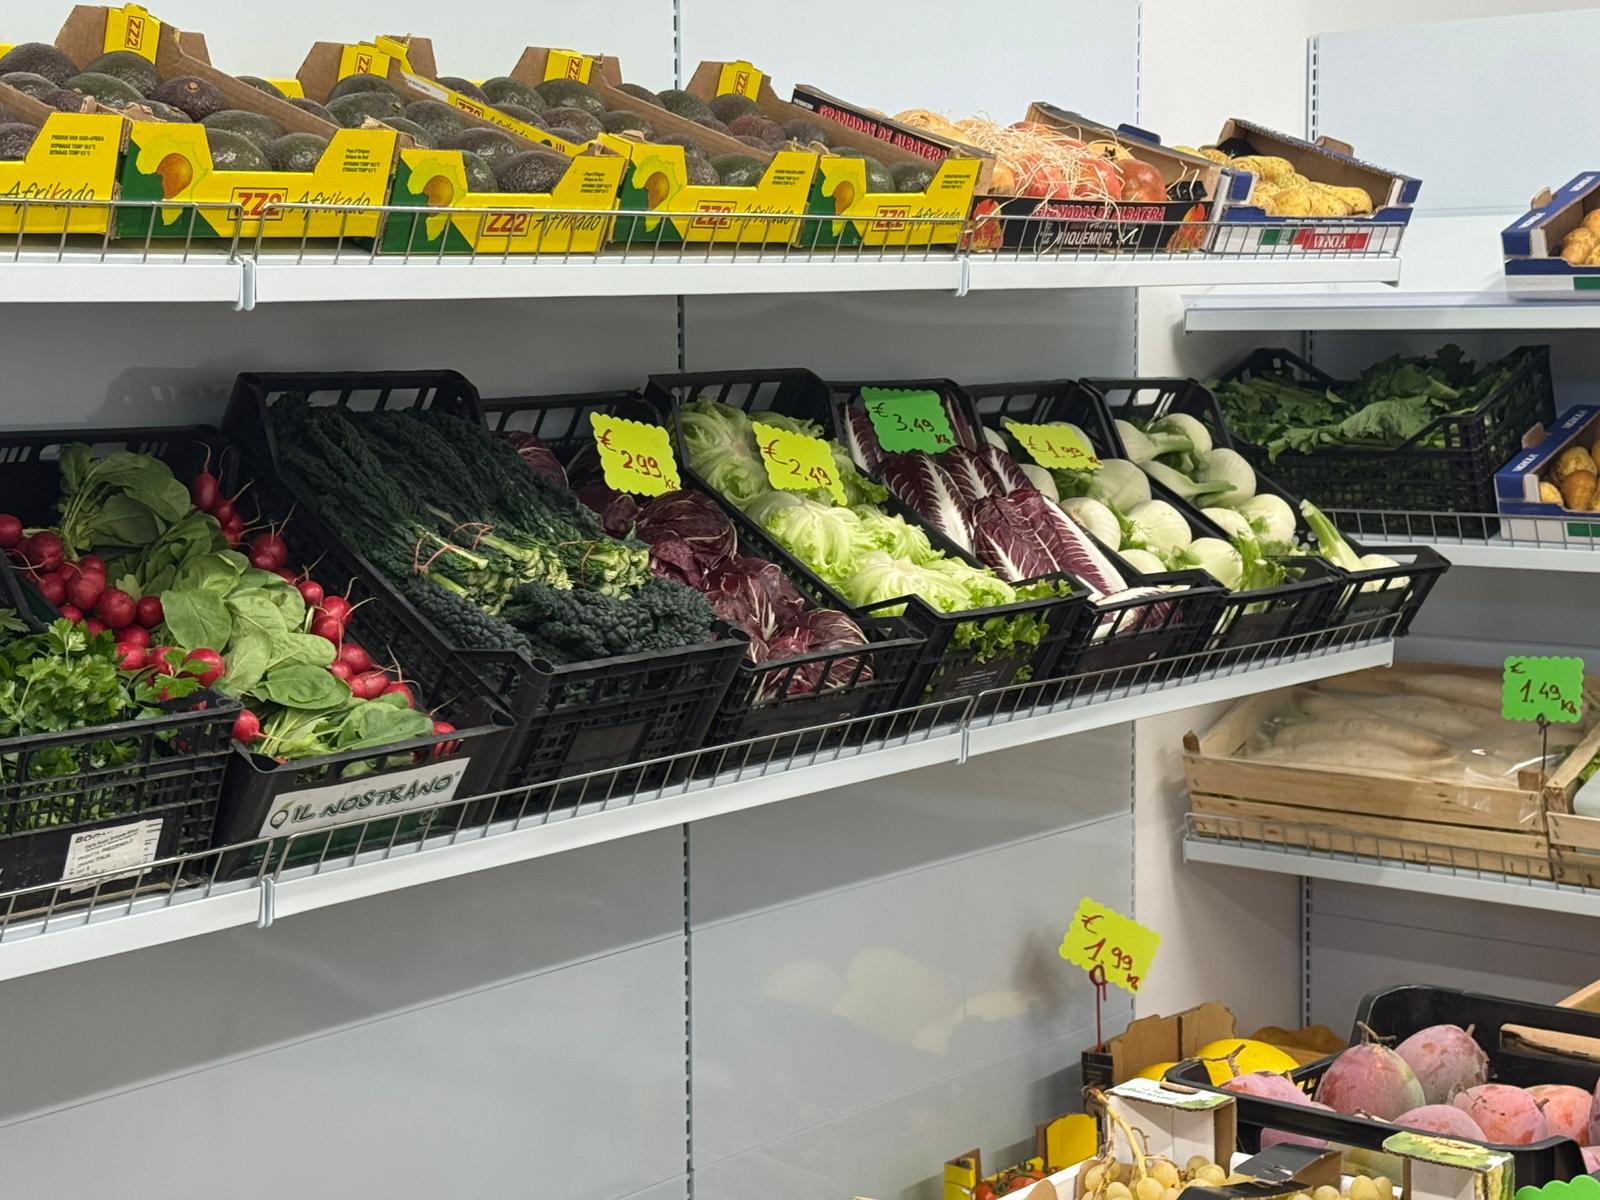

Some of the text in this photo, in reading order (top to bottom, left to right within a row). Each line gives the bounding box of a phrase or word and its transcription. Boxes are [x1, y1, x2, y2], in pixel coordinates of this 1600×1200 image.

[126, 18, 142, 47] ZZ2
[357, 56, 370, 74] ZZ
[234, 191, 371, 220] ZZ2 Afrikado
[695, 205, 733, 226] ZZ2
[486, 211, 529, 233] ZZ2
[871, 401, 889, 418] €
[892, 413, 936, 433] 3.49
[762, 438, 833, 486] € 2.49
[1520, 678, 1562, 704] 1.49
[291, 772, 455, 824] IL NOSTRANO
